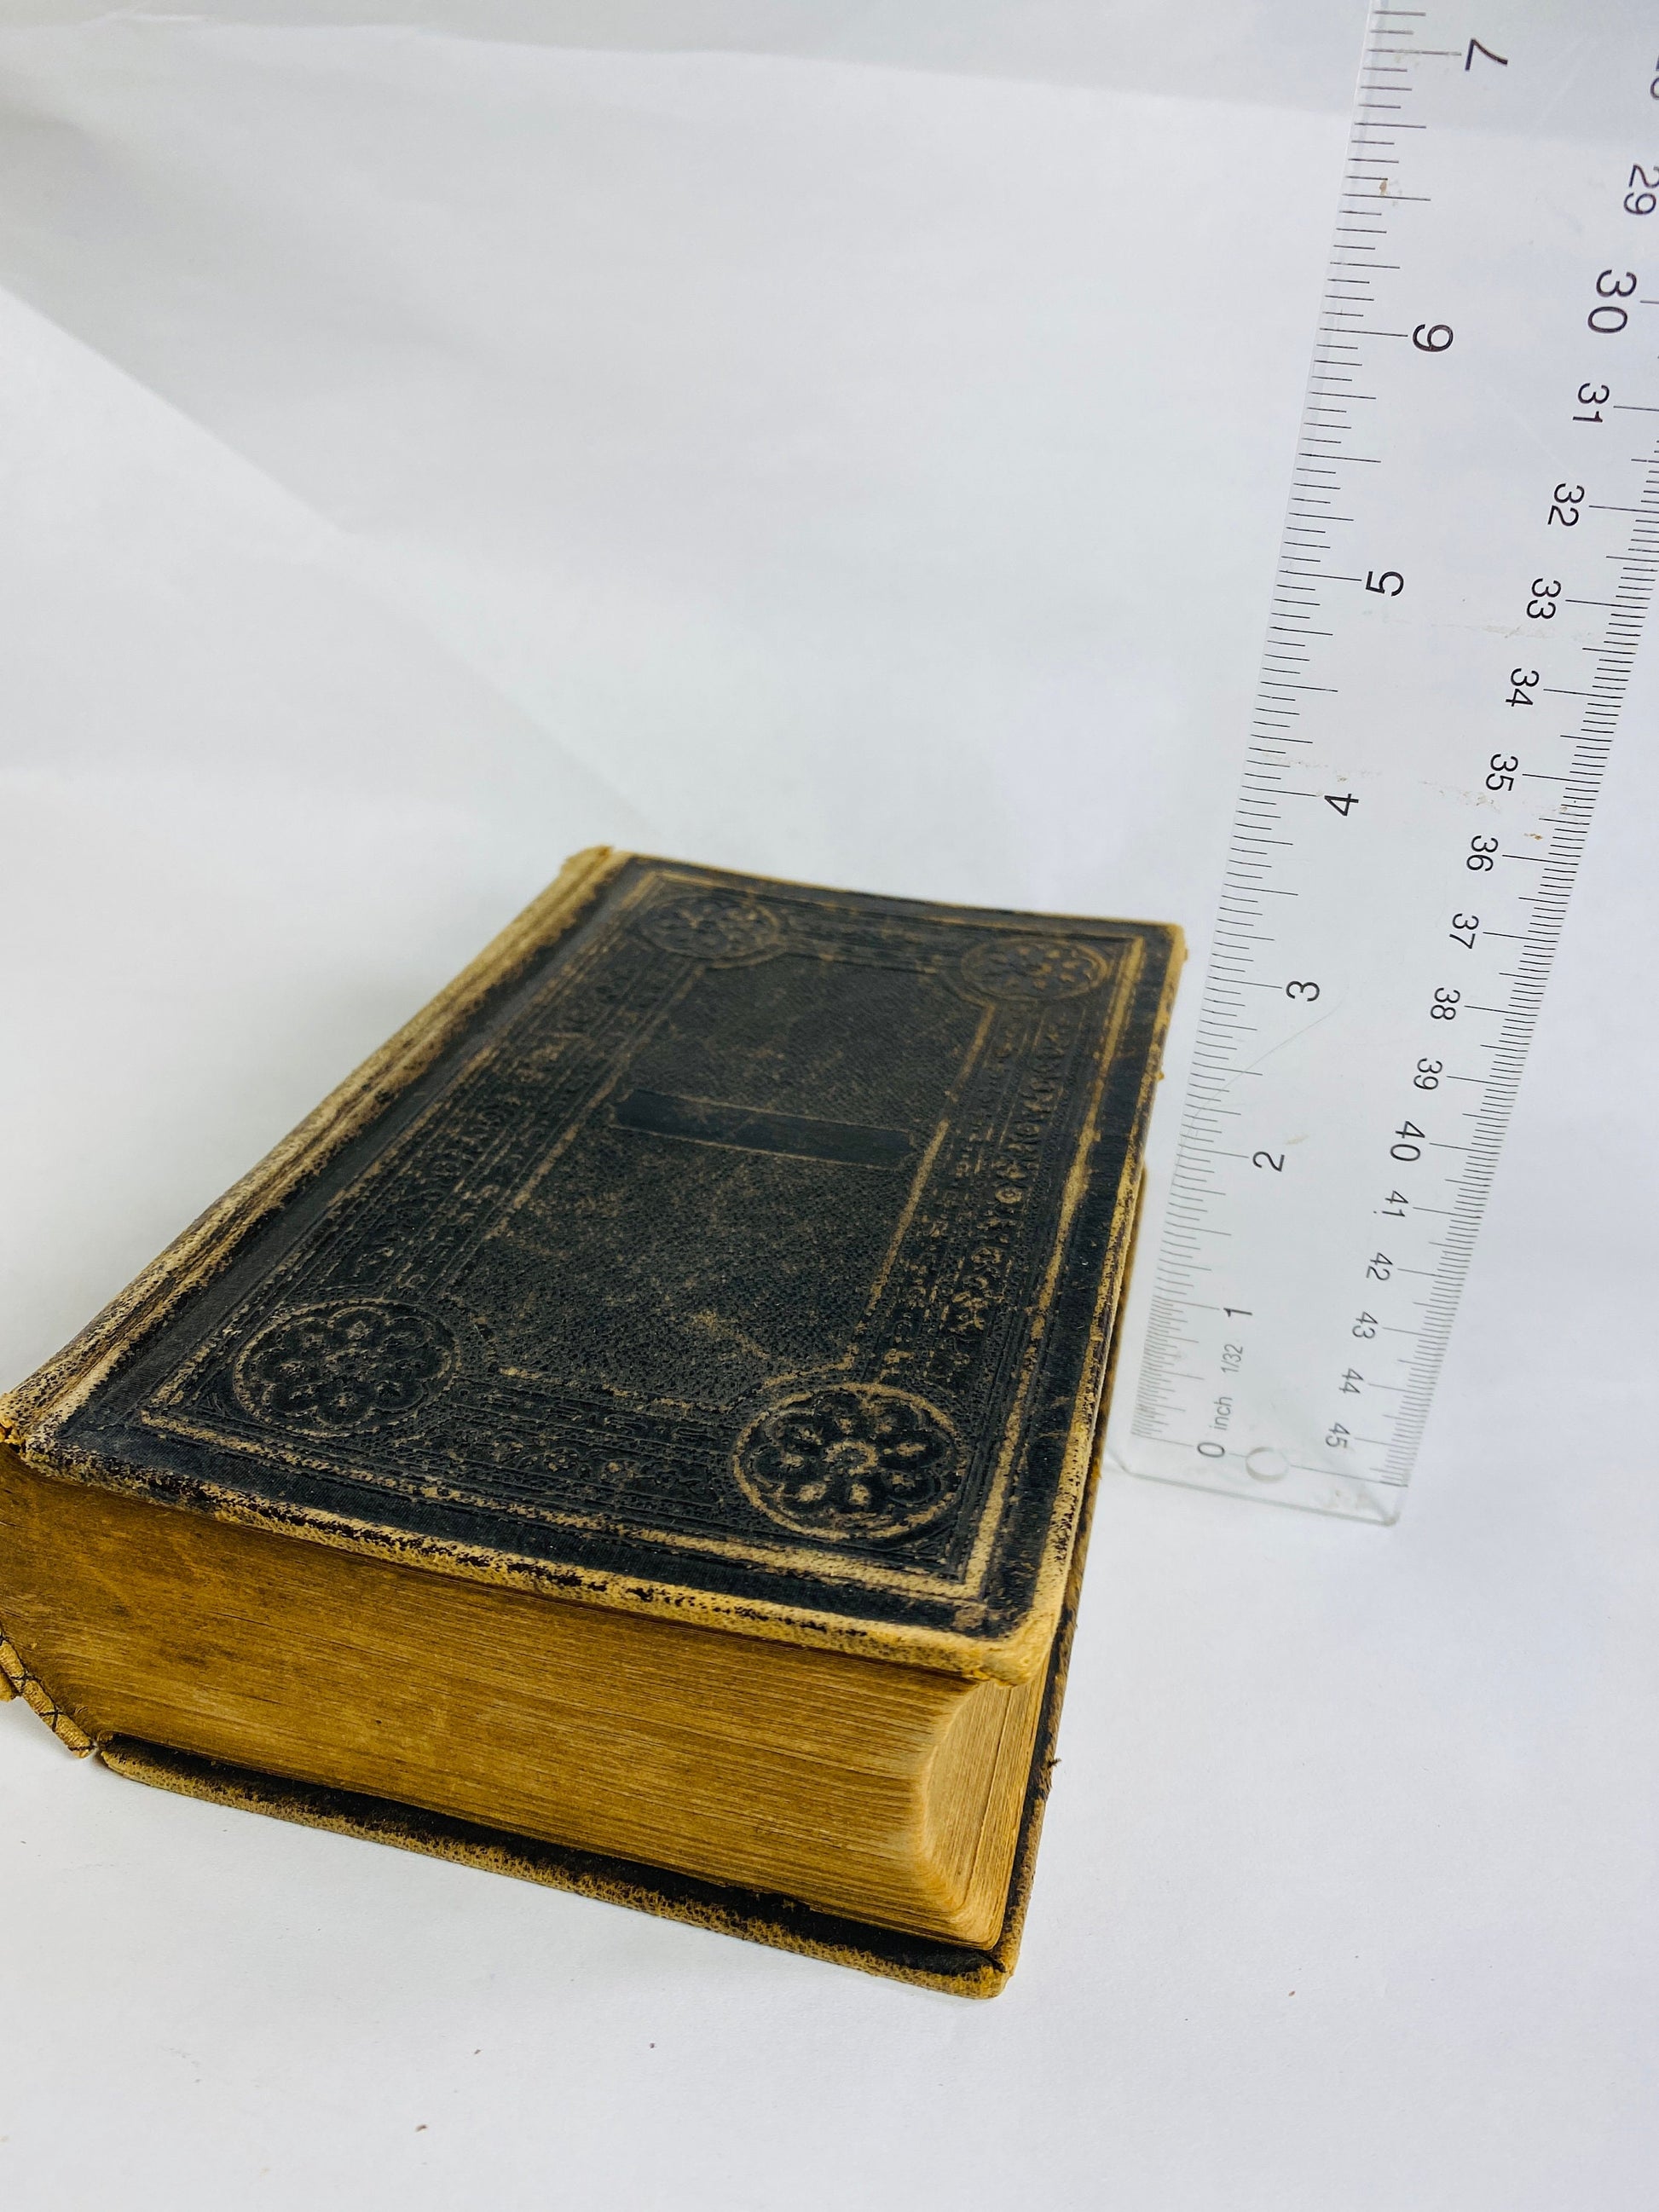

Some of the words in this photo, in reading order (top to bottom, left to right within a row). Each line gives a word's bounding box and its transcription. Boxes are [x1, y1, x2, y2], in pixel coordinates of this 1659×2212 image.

[1465, 38, 1509, 72] 7
[1623, 164, 1659, 216] 29
[1587, 269, 1638, 334] 30
[1412, 323, 1454, 353] 6
[1572, 382, 1610, 424] 31
[1547, 482, 1585, 527] 32
[1365, 570, 1404, 598] 5
[1526, 578, 1562, 620] 33
[1505, 667, 1540, 707] 34
[1485, 754, 1519, 792] 35
[1324, 793, 1360, 817] 4
[1465, 835, 1499, 872] 36
[1448, 913, 1480, 950] 37
[1286, 980, 1321, 1002] 3
[1430, 987, 1461, 1020] 38
[1413, 1057, 1443, 1090] 39
[1390, 1120, 1425, 1162] 40
[1252, 1151, 1286, 1172] 2
[1381, 1190, 1409, 1220] 41
[1366, 1252, 1394, 1281] 42
[1223, 1307, 1253, 1318] 1
[1351, 1311, 1379, 1339] 43
[1220, 1343, 1244, 1373] 1/32
[1338, 1368, 1364, 1395] 44
[1209, 1396, 1234, 1431] inch
[1196, 1441, 1226, 1458] 0
[1325, 1422, 1351, 1449] 45
